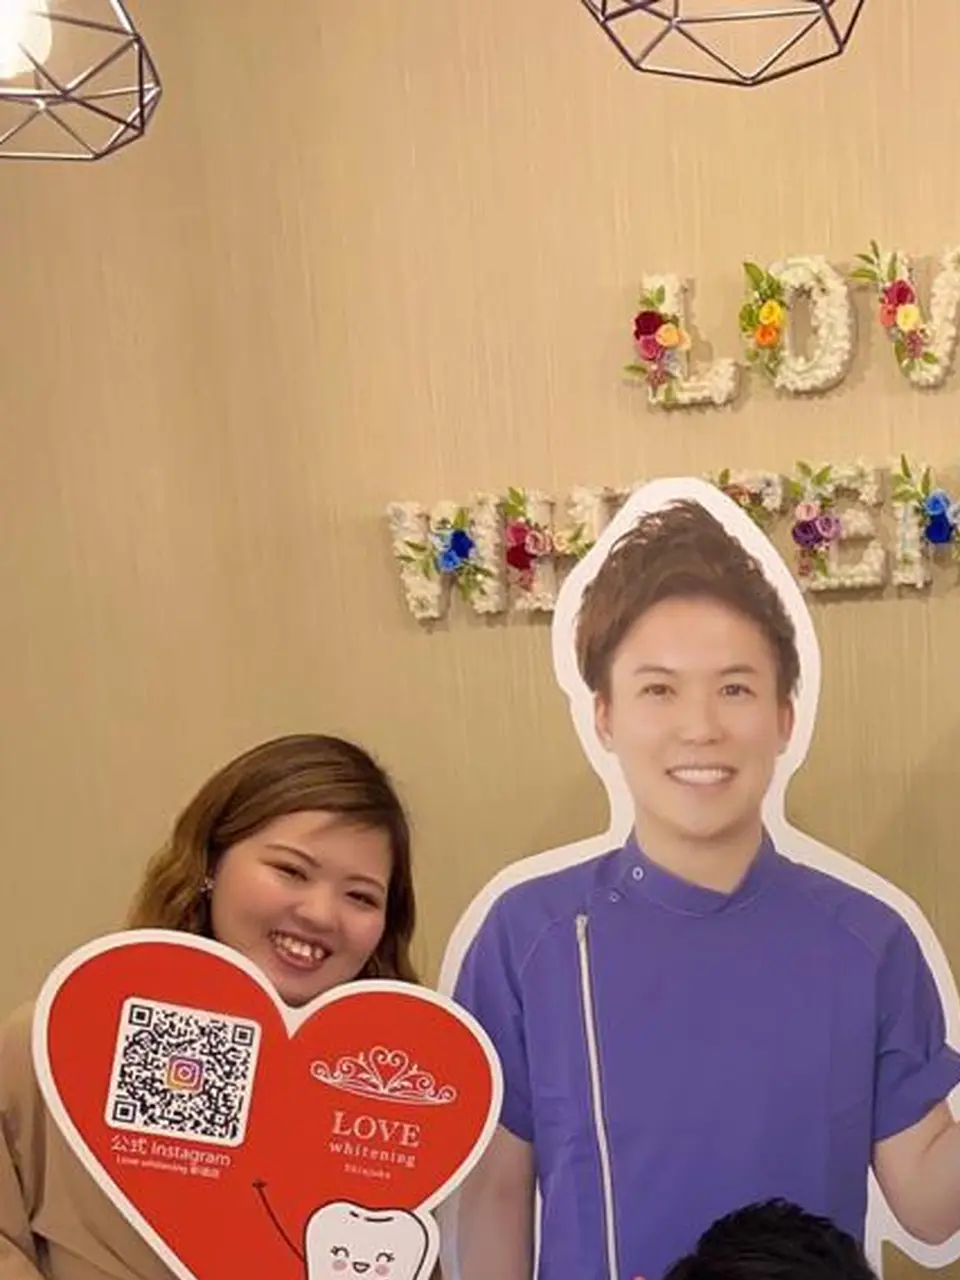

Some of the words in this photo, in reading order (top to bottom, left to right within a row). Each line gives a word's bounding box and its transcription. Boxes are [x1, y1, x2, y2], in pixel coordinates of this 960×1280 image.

[332, 1109, 422, 1149] LOVE
[150, 1140, 232, 1168] Instagram
[329, 1140, 417, 1169] whitening
